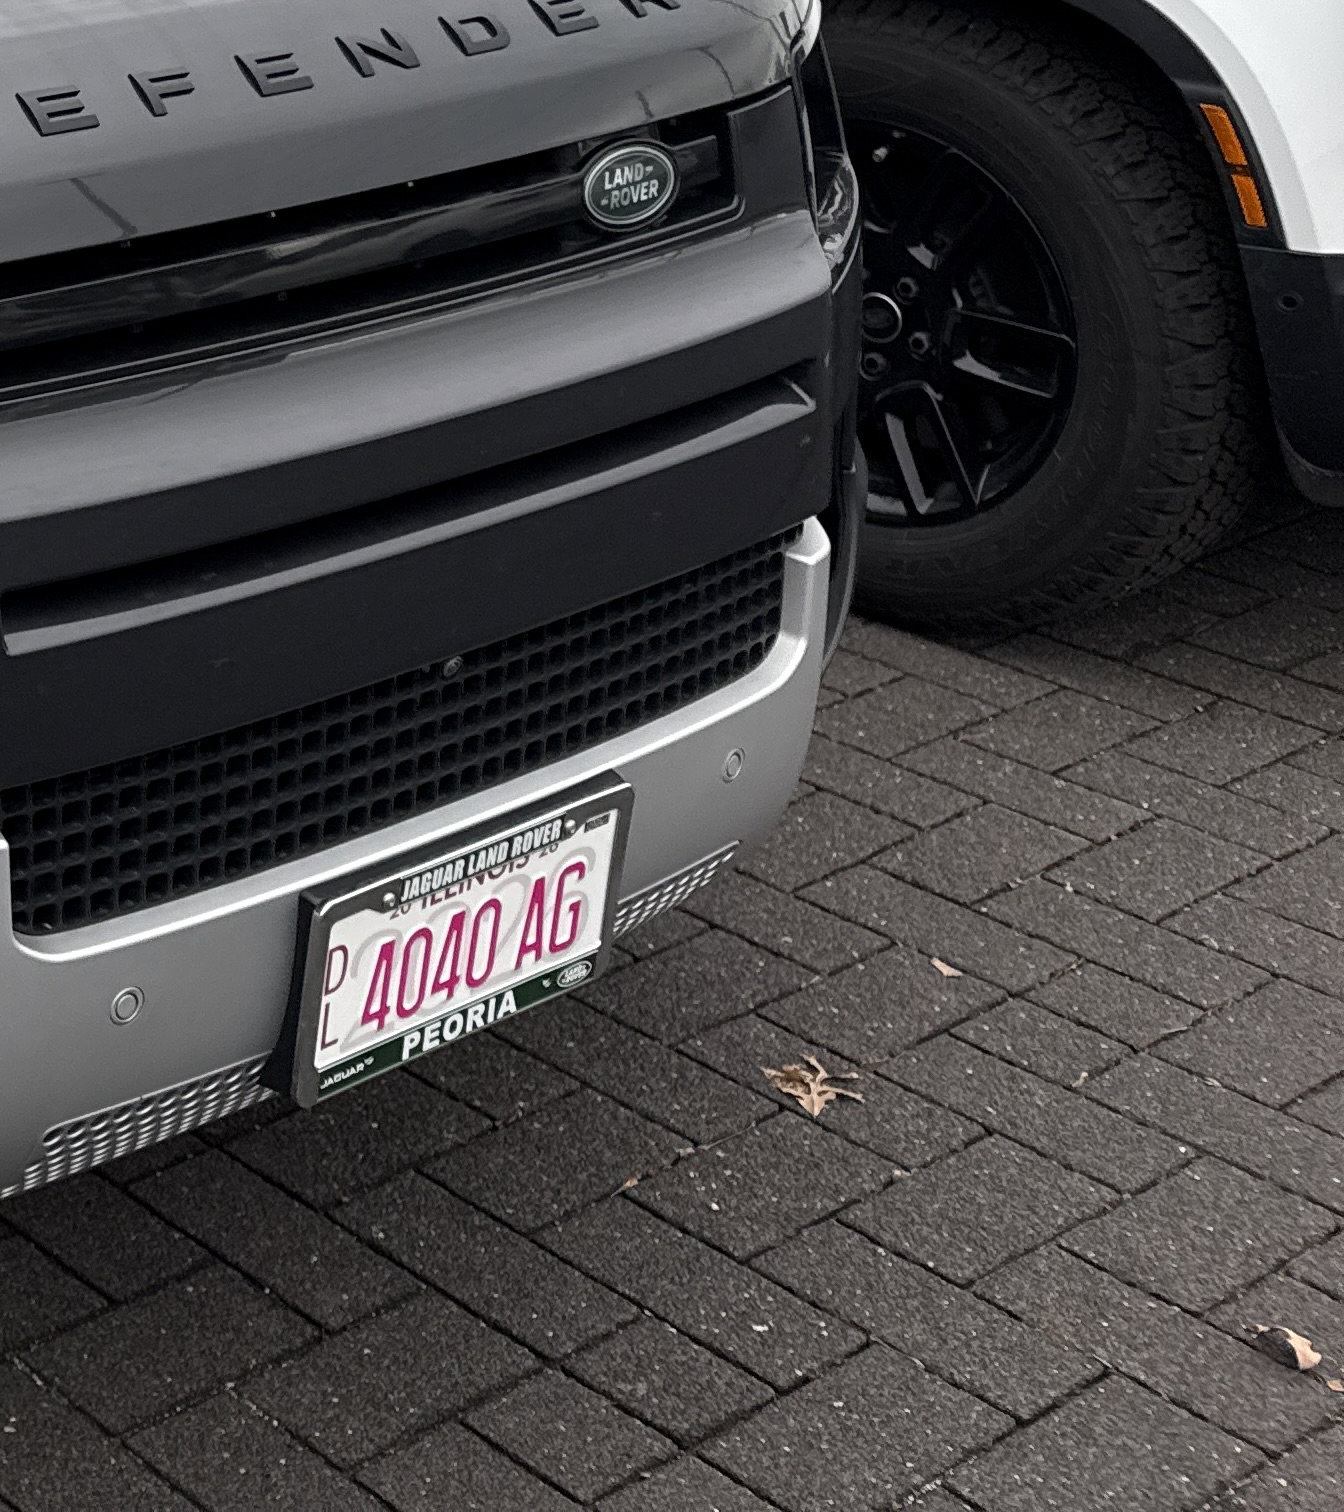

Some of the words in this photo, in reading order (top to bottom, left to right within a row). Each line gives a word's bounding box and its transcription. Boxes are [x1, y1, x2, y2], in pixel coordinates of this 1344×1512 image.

[604, 162, 644, 190] LAND
[610, 179, 659, 208] ROVER
[400, 858, 466, 903] JAGUAR
[467, 841, 510, 876] LAND
[511, 818, 562, 859] ROVER
[361, 897, 503, 1032] 4040
[514, 860, 587, 971] AG
[401, 989, 518, 1062] PEORIA
[319, 1062, 365, 1090] JAGUAR
